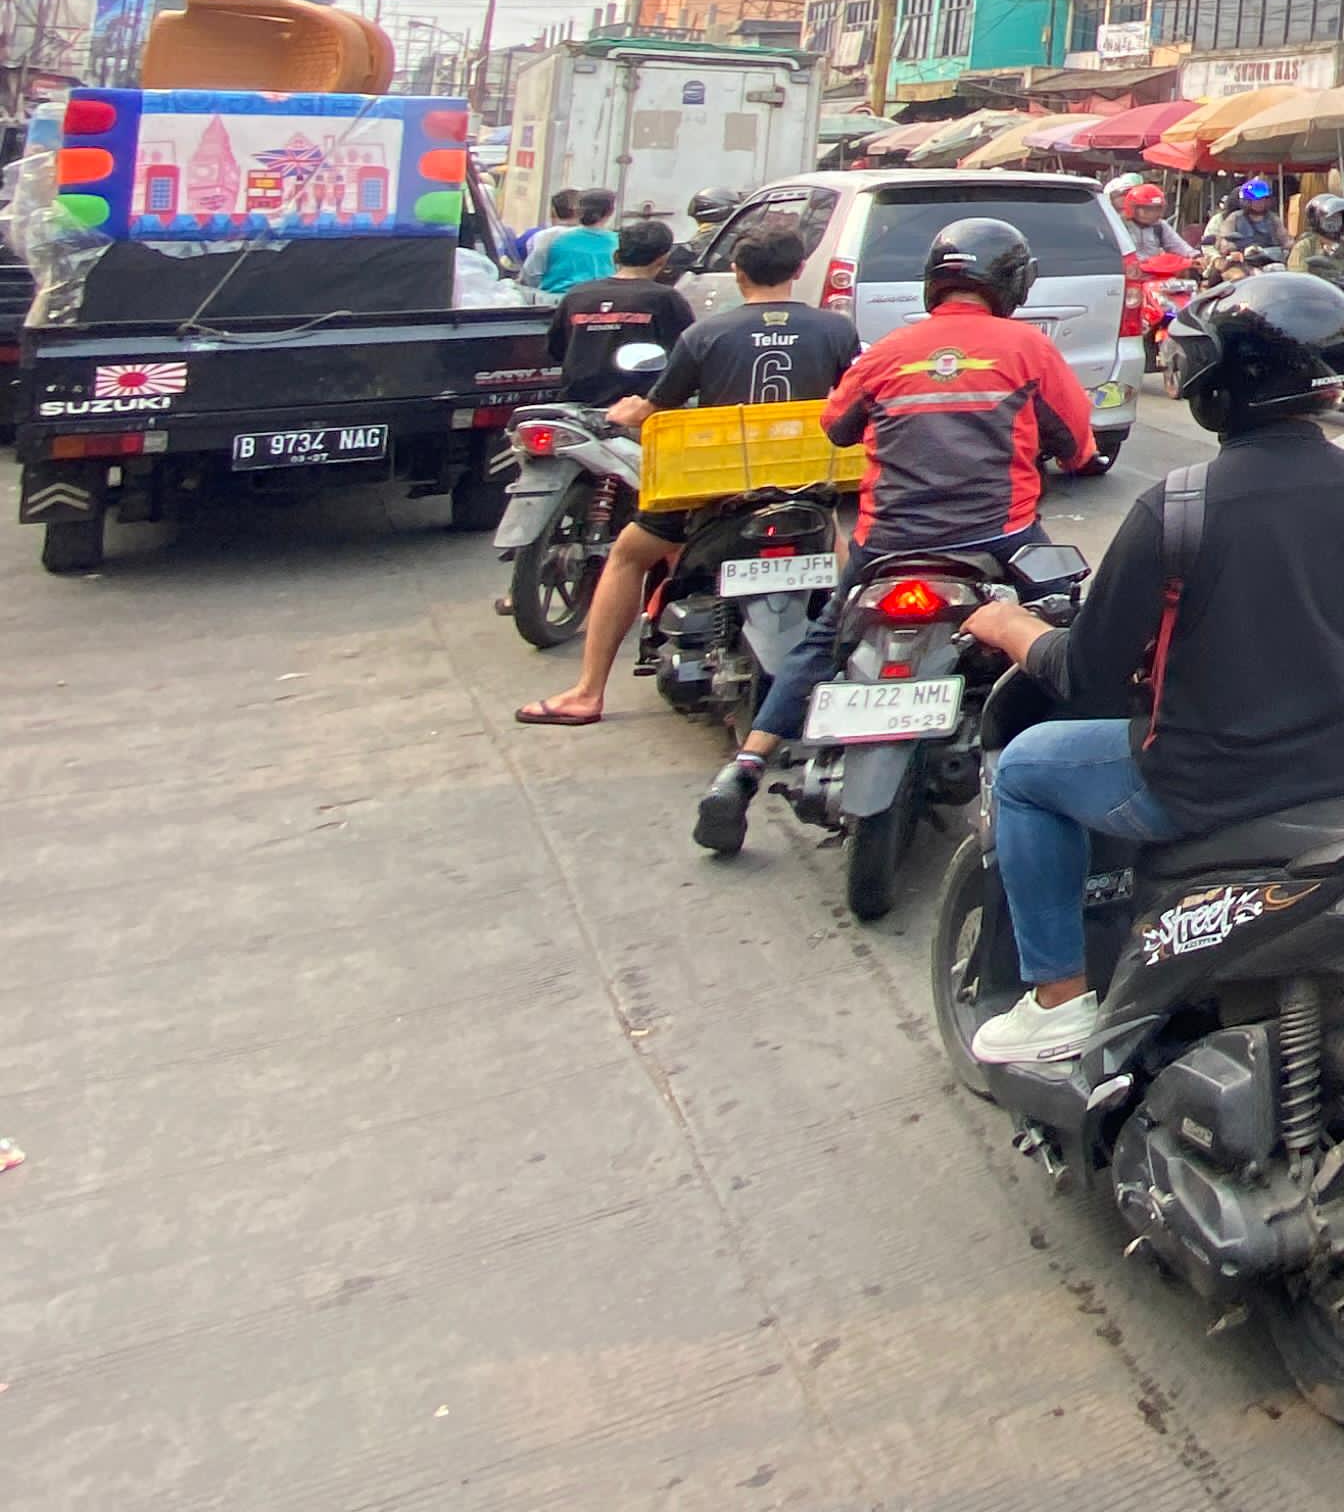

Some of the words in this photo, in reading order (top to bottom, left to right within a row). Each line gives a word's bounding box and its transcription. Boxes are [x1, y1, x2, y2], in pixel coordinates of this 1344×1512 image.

[751, 332, 799, 348] Telur
[750, 350, 793, 404] 6
[39, 395, 172, 416] SUZUKI
[239, 438, 255, 458] B
[270, 431, 325, 455] 9734
[339, 427, 381, 450] NAG
[726, 564, 737, 578] B
[749, 559, 792, 575] 6917
[818, 691, 833, 710] B
[847, 687, 901, 708] 4122
[913, 684, 951, 705] NML
[1160, 887, 1233, 955] Street
